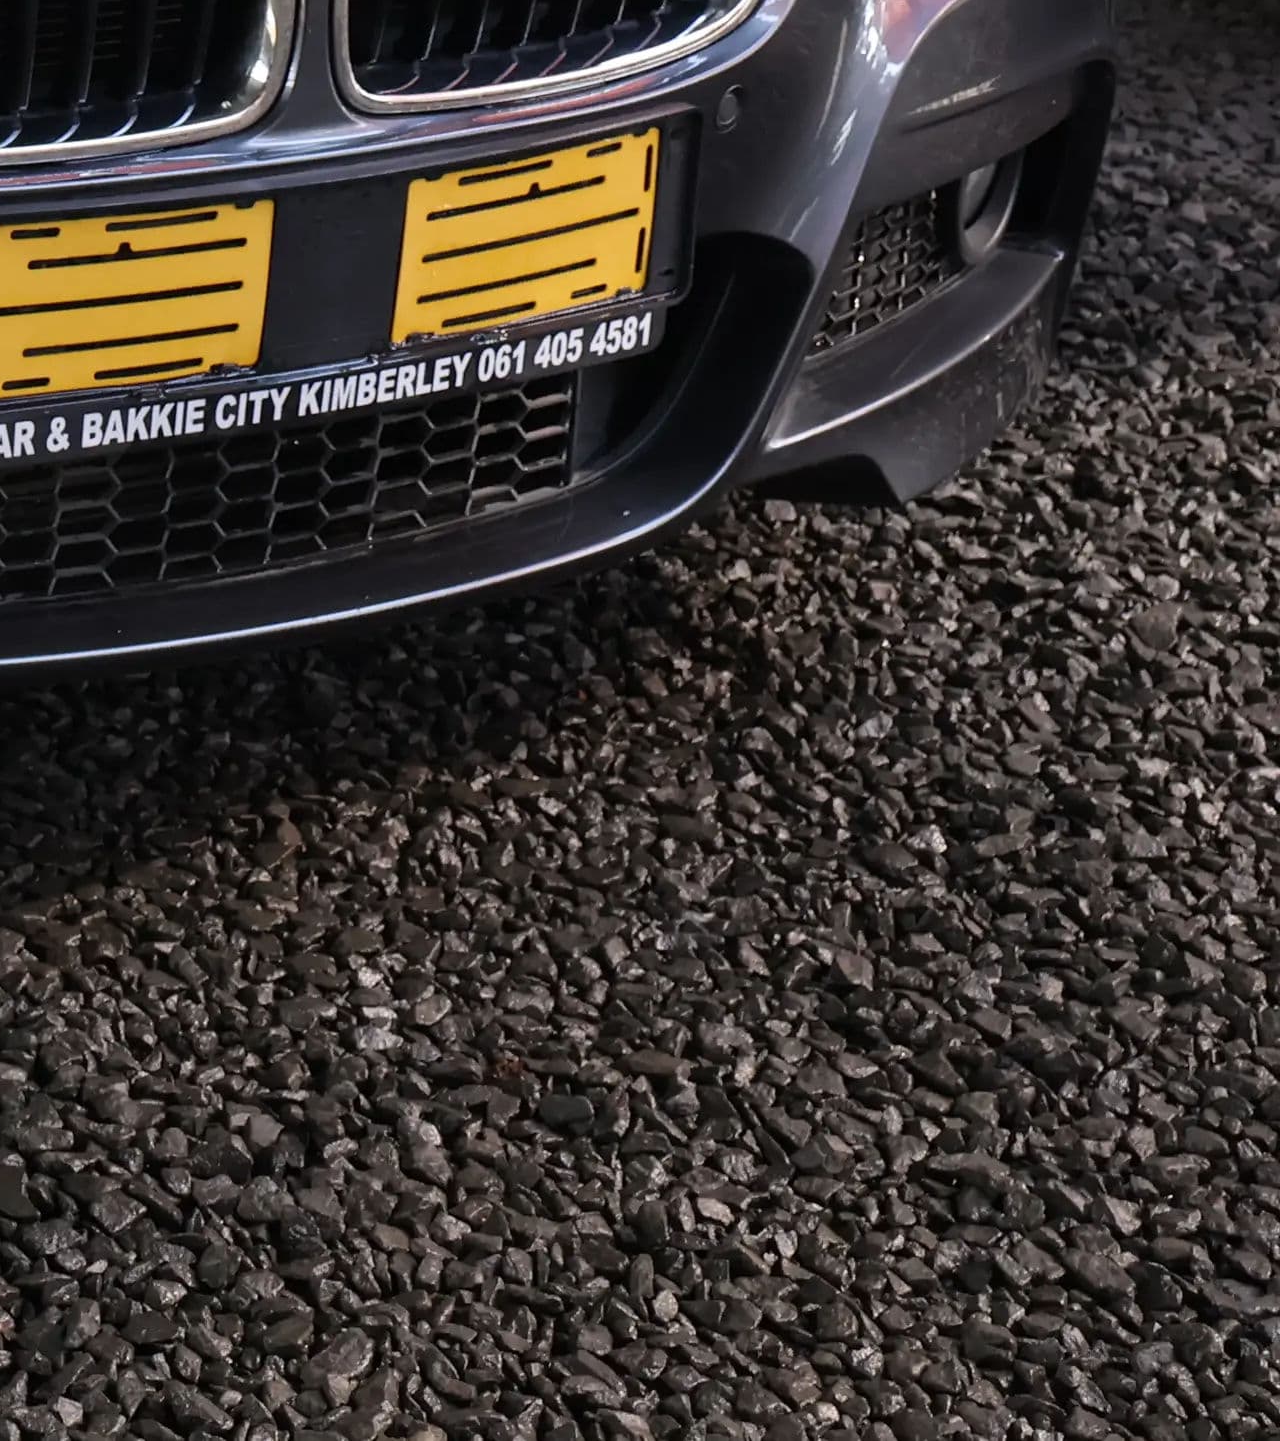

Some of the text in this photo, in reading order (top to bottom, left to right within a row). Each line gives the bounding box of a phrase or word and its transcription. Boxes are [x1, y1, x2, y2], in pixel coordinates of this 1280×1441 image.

[46, 416, 70, 453] &
[81, 398, 207, 449] BAKKIE
[214, 386, 292, 430] CITY
[297, 352, 474, 417] KIMBERLEY
[477, 340, 528, 383] 061
[534, 327, 584, 370] 405
[590, 311, 653, 357] 4581
